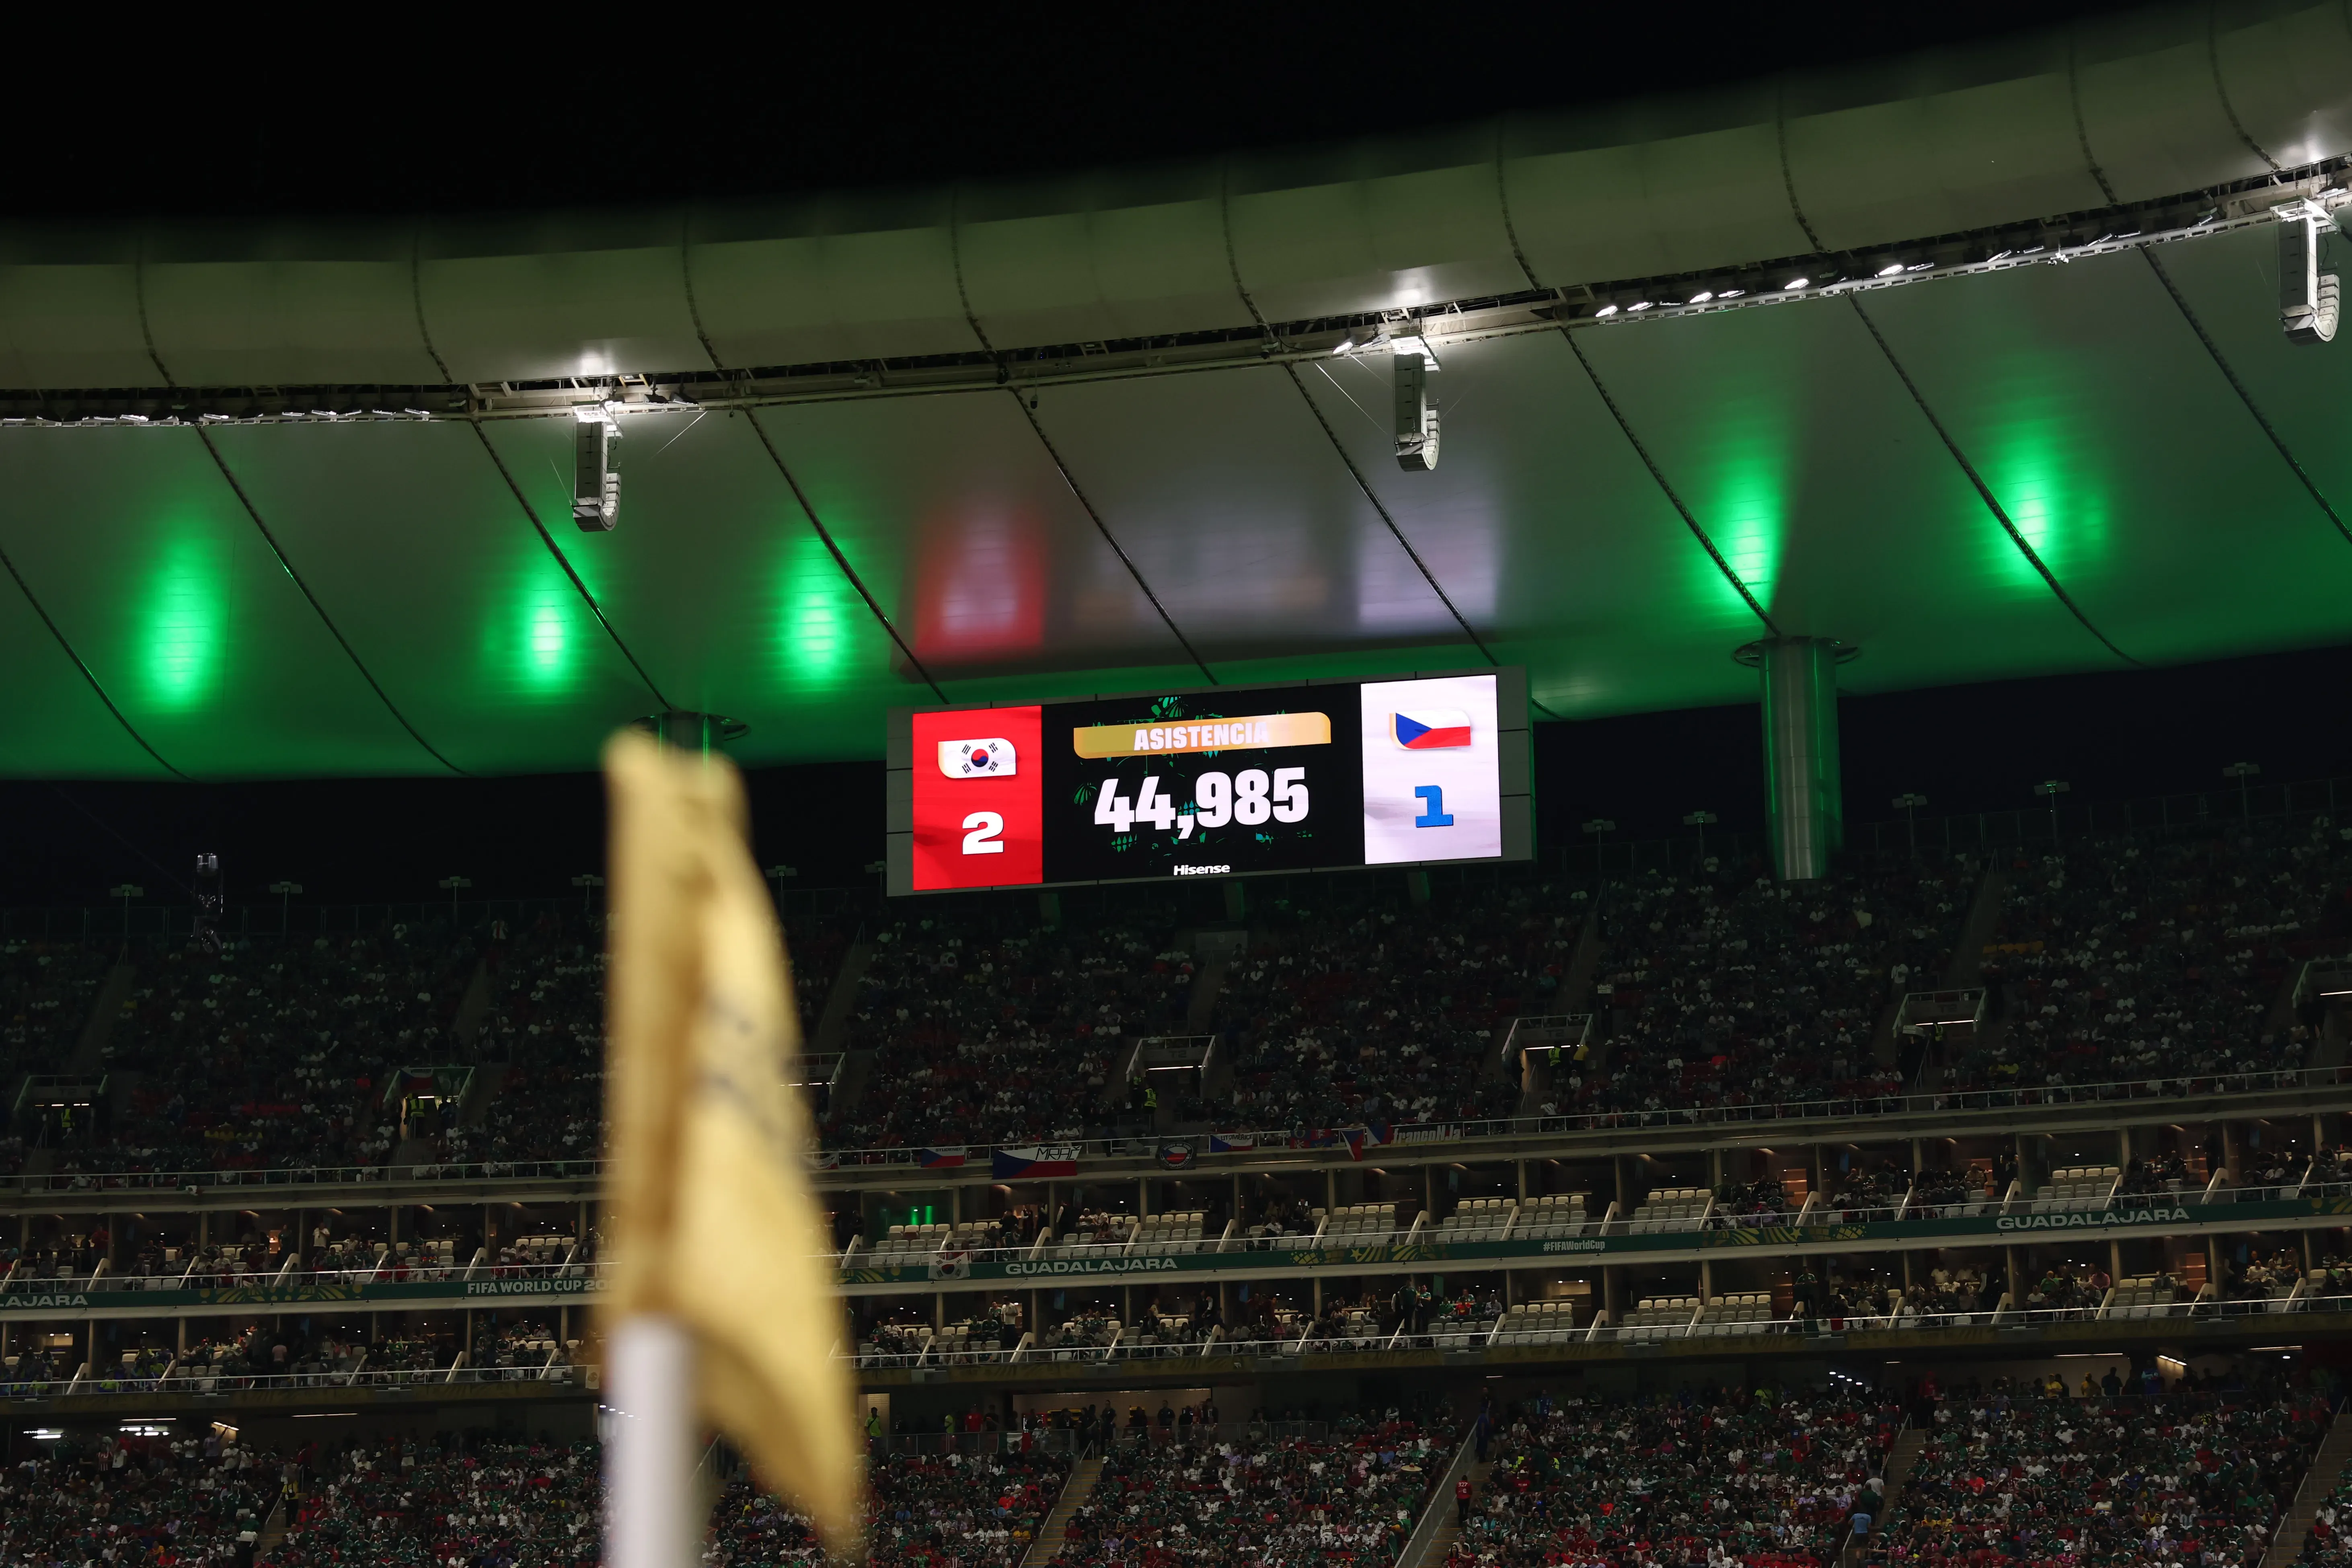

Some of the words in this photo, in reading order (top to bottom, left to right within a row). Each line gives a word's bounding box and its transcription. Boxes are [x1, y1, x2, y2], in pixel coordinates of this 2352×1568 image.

[1134, 722, 1268, 751] ASISTENCIA
[1094, 767, 1309, 840] 44,985
[1414, 785, 1454, 828] 1
[961, 812, 1005, 855] 2
[1173, 863, 1230, 877] Hisense
[1939, 1004, 1957, 1012] T2
[1546, 1029, 1564, 1038] T2
[1169, 1050, 1187, 1058] T2
[60, 1088, 76, 1096] T2
[1035, 1146, 1080, 1160] MRAČ
[1996, 1207, 2190, 1229] GUADALAJARA
[1543, 1239, 1605, 1252] #FIFAWorldCup
[1005, 1258, 1178, 1275] GUADALAJARA
[467, 1282, 498, 1294] FIFA
[500, 1281, 551, 1293] WORLD
[554, 1280, 582, 1291] CUP
